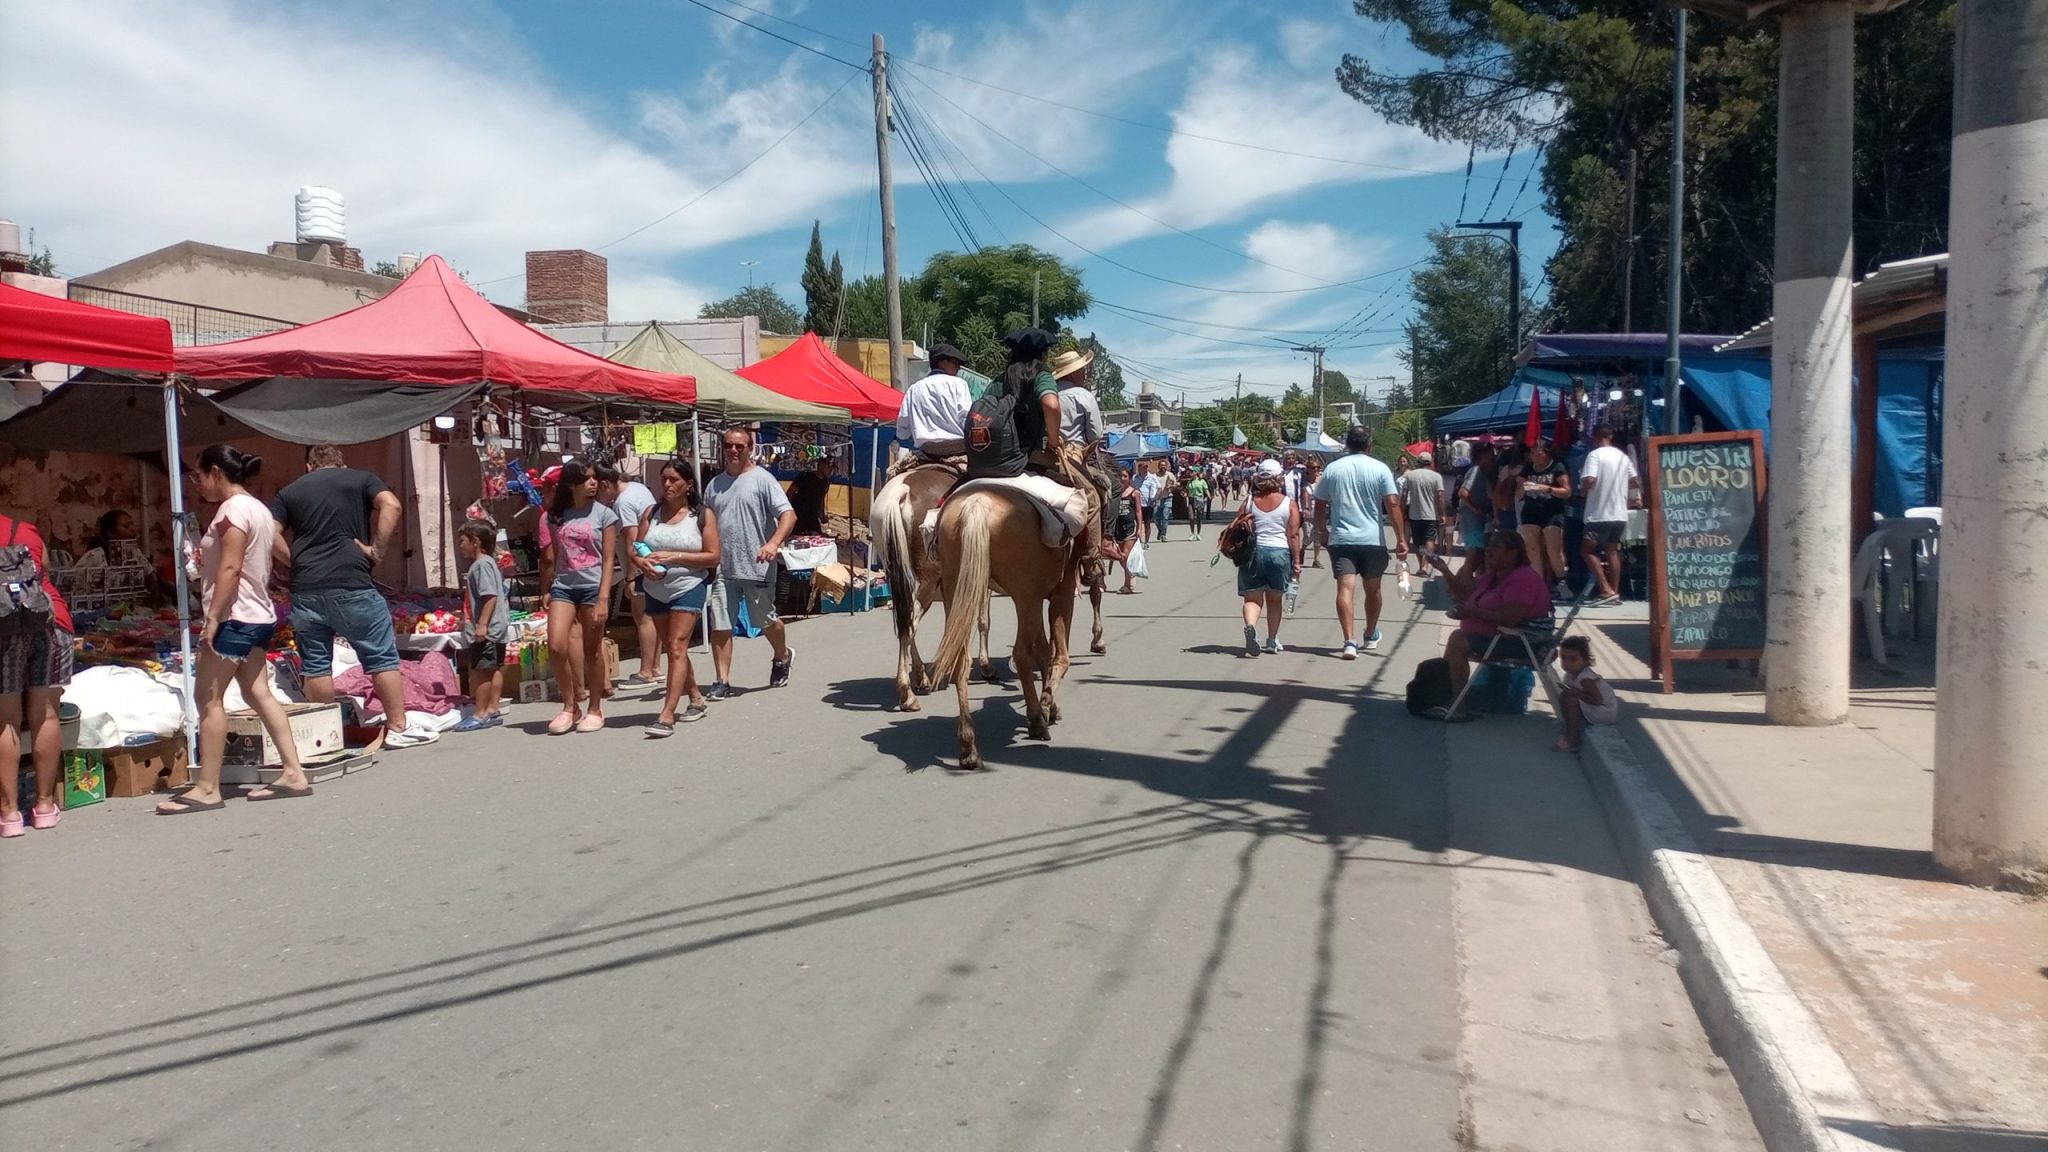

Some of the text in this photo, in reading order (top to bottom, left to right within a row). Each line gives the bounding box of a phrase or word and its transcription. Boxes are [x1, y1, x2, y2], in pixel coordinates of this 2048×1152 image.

[1666, 466, 1749, 489] LOCRO
[1663, 489, 1716, 507] PANCETA
[1664, 507, 1708, 521] PATITAS
[1667, 533, 1732, 551] CUERITOS
[1667, 564, 1733, 577] MONDONGO
[1673, 627, 1729, 644] ZAPALLO
